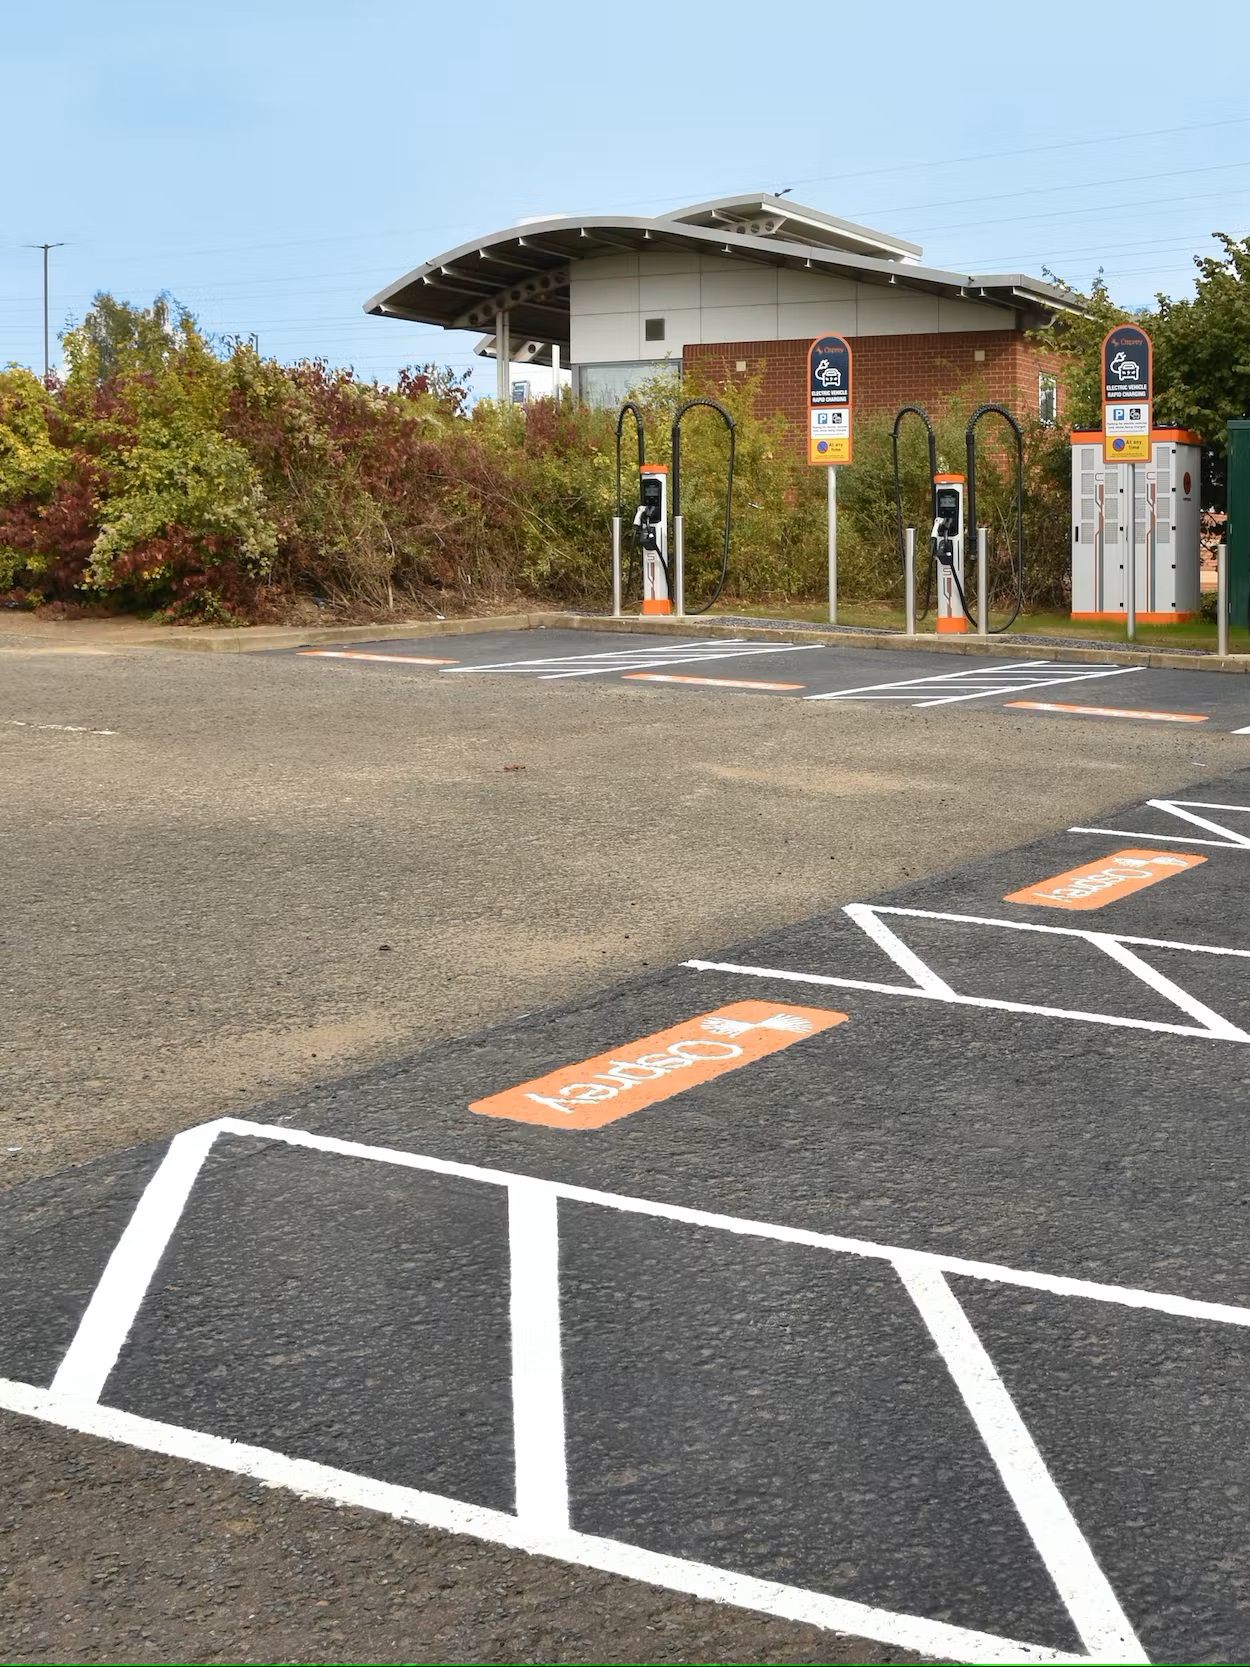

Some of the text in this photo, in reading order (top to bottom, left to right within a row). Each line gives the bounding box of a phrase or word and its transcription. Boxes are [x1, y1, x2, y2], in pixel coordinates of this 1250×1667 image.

[1120, 338, 1143, 346] Osprey
[819, 414, 827, 424] P
[1115, 409, 1123, 420] P
[1032, 866, 1153, 903] Osprey
[524, 1039, 744, 1114] Osprey
